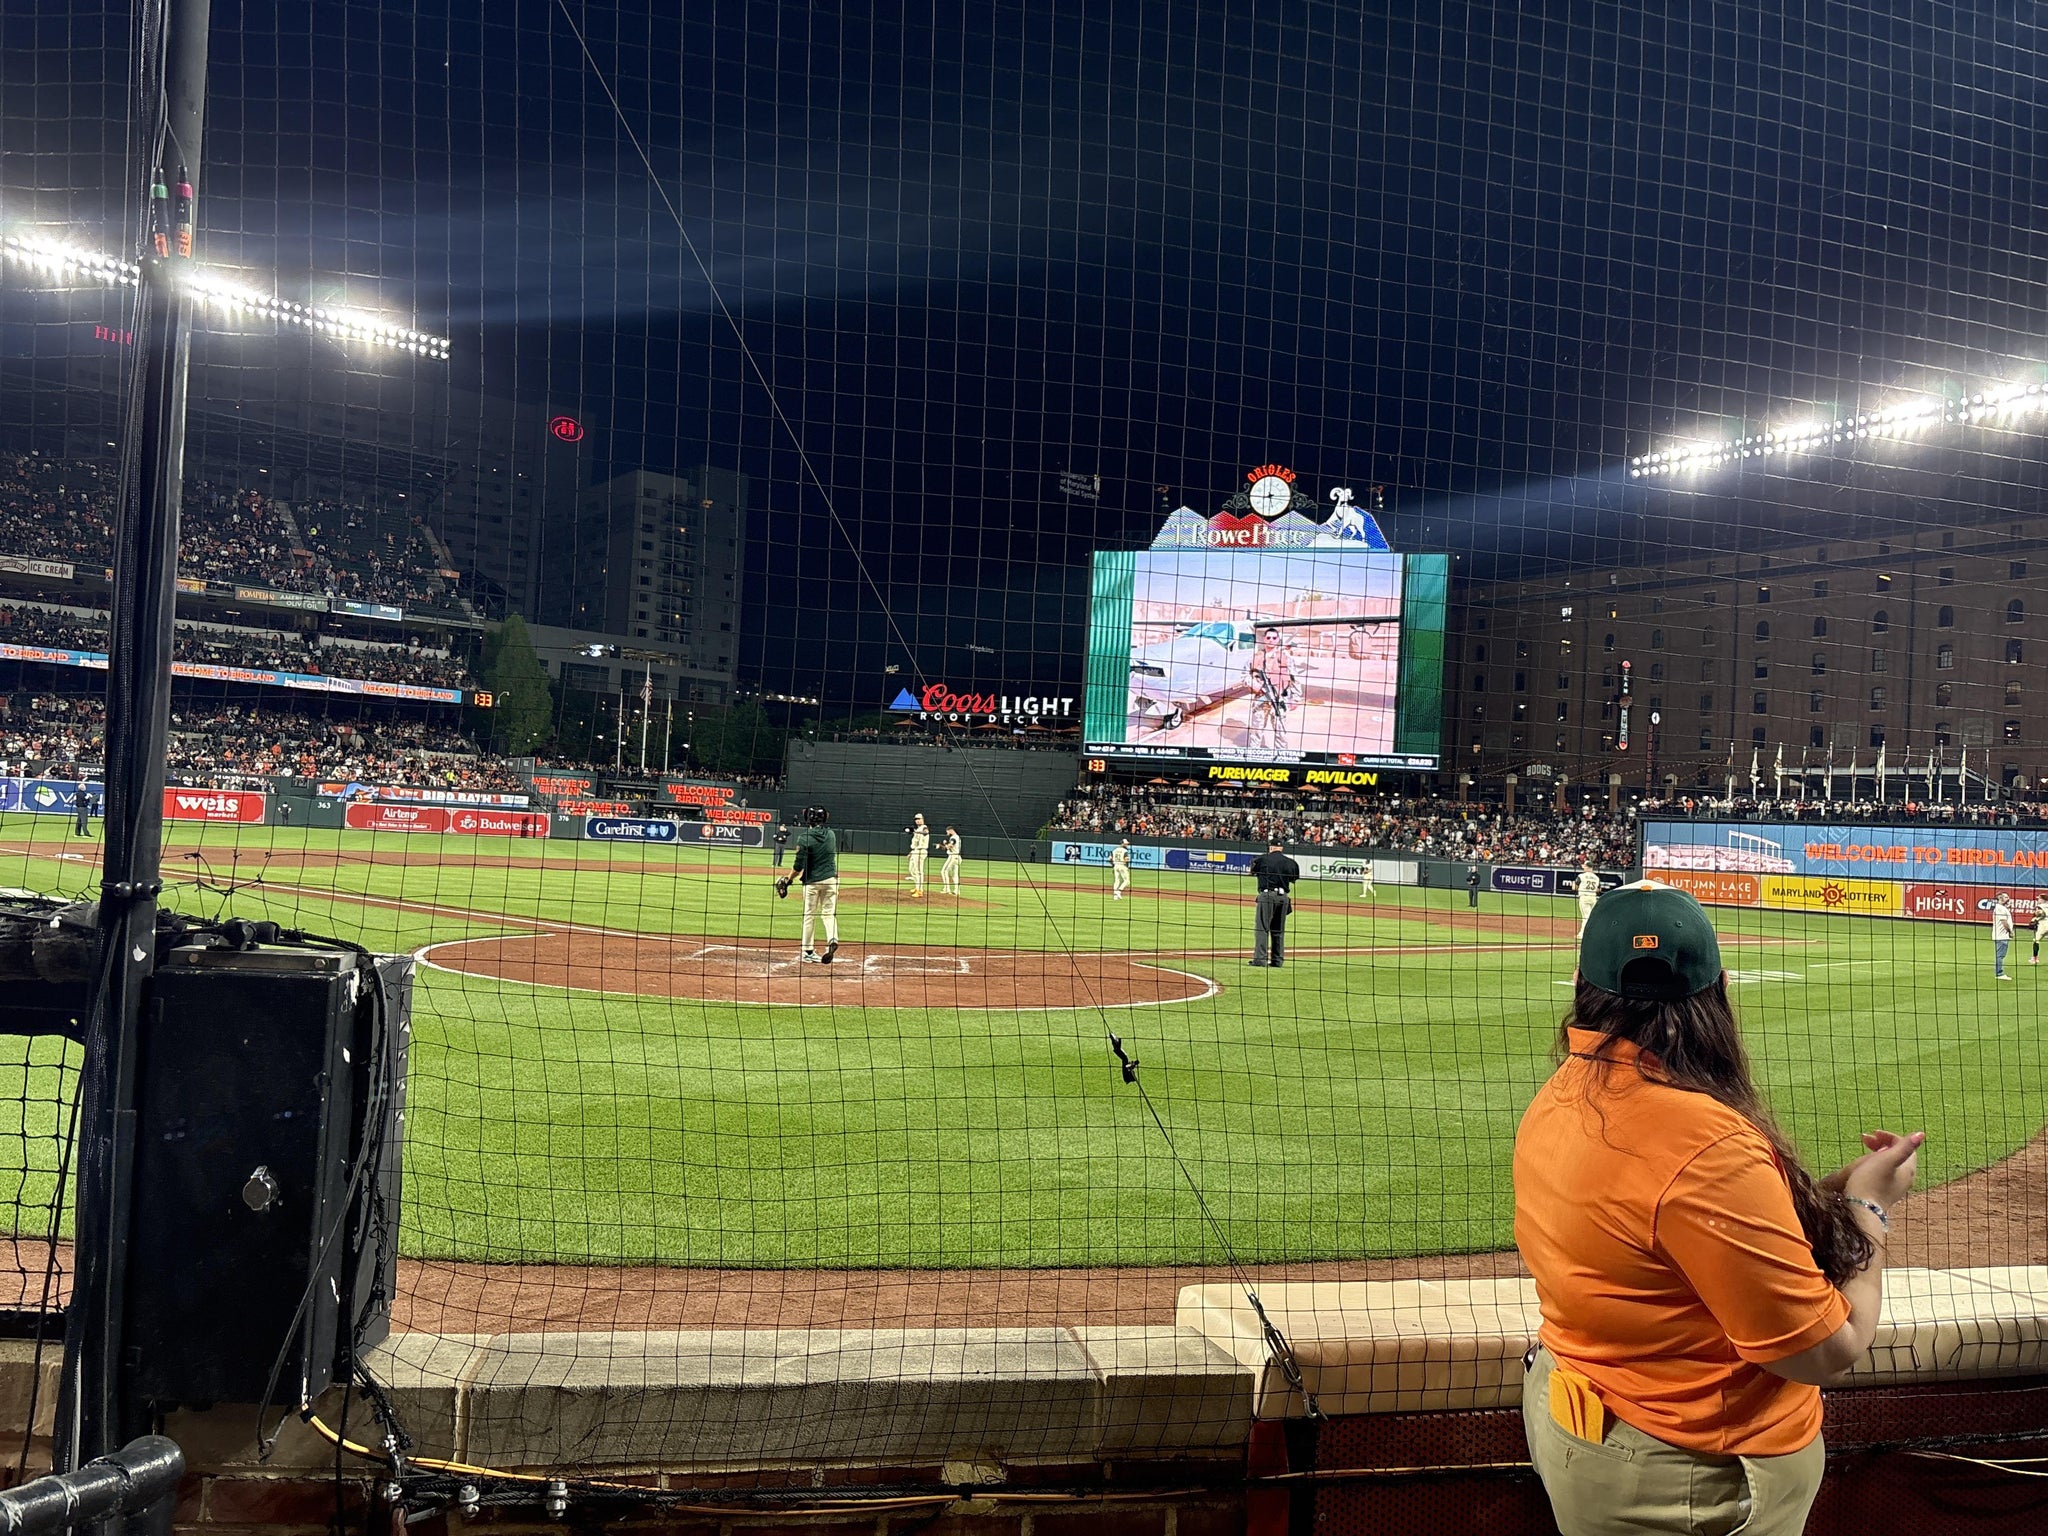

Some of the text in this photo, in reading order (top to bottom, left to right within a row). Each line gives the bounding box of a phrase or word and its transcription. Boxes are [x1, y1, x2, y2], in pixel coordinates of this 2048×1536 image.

[1247, 464, 1296, 483] ORIOLES
[31, 562, 69, 576] ICE CREAM
[239, 590, 275, 601] POMPEIAN
[2, 647, 69, 662] TO BIRDLAND
[217, 668, 229, 678] TO
[230, 670, 276, 683] BIRDLAND
[361, 682, 454, 700] WELCOME TO BIRDLAND
[922, 683, 1074, 716] Coors LIGHT
[920, 712, 1039, 724] ROOF DECK
[532, 777, 590, 788] WELCOME TO
[1208, 767, 1377, 786] PUREWAGER PAVILION
[458, 792, 491, 804] BATH
[667, 784, 734, 798] WELCOME TO
[176, 794, 238, 812] weis
[613, 803, 629, 813] TO
[675, 795, 725, 807] BIRDLAND
[383, 808, 418, 820] Airtemp
[705, 809, 772, 822] WELCOME TO
[596, 821, 645, 837] CareFirst
[715, 826, 741, 838] PNC
[1804, 843, 1907, 864] WELCOME
[1912, 846, 1942, 865] TO
[1501, 874, 1531, 885] TRUIST
[1586, 880, 1596, 890] 25
[1669, 879, 1751, 893] AUTUMN LAKE
[1772, 888, 1821, 899] MARYLAND
[1844, 892, 1887, 902] LOTTERY
[1916, 896, 1965, 915] HIGH'S
